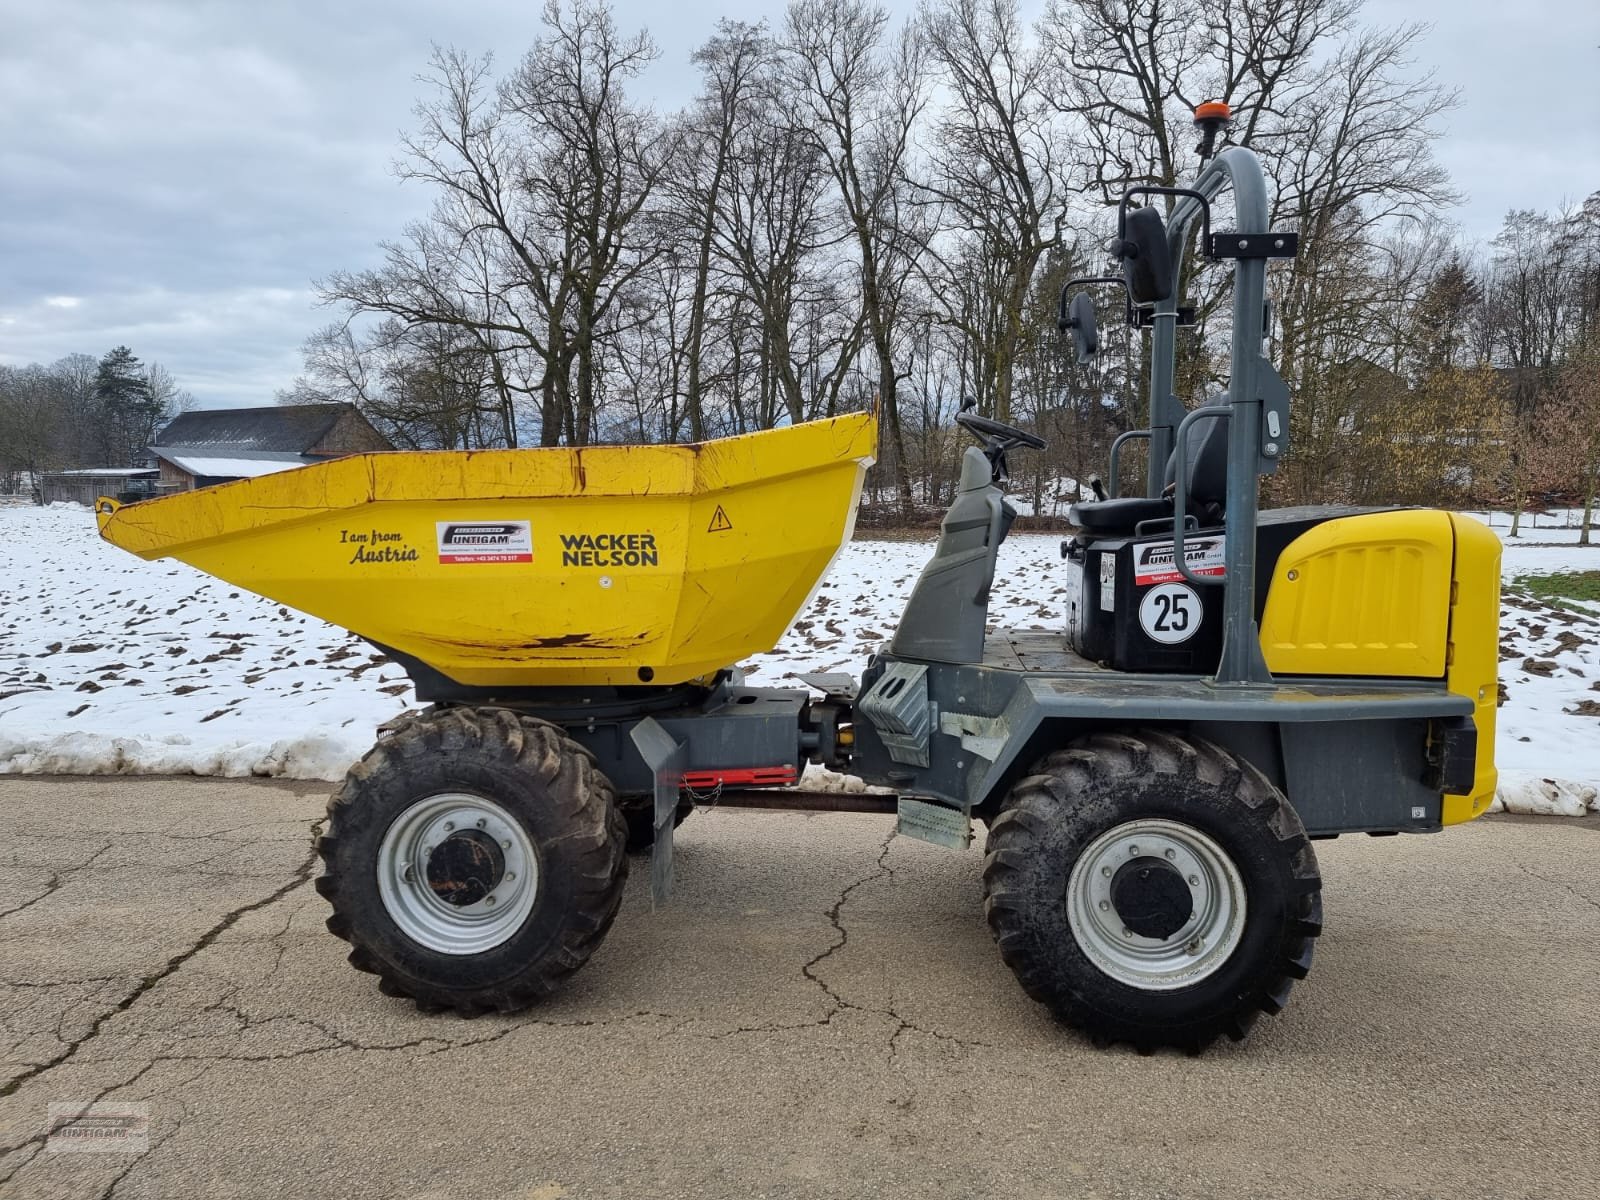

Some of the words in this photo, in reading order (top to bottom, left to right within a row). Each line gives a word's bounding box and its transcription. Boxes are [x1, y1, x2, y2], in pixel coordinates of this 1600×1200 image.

[340, 530, 348, 543] I
[350, 534, 368, 542] am
[371, 529, 403, 546] from
[560, 534, 657, 550] WACKER
[349, 545, 419, 565] Austria
[563, 551, 658, 567] NELSON
[1154, 594, 1189, 632] 25
